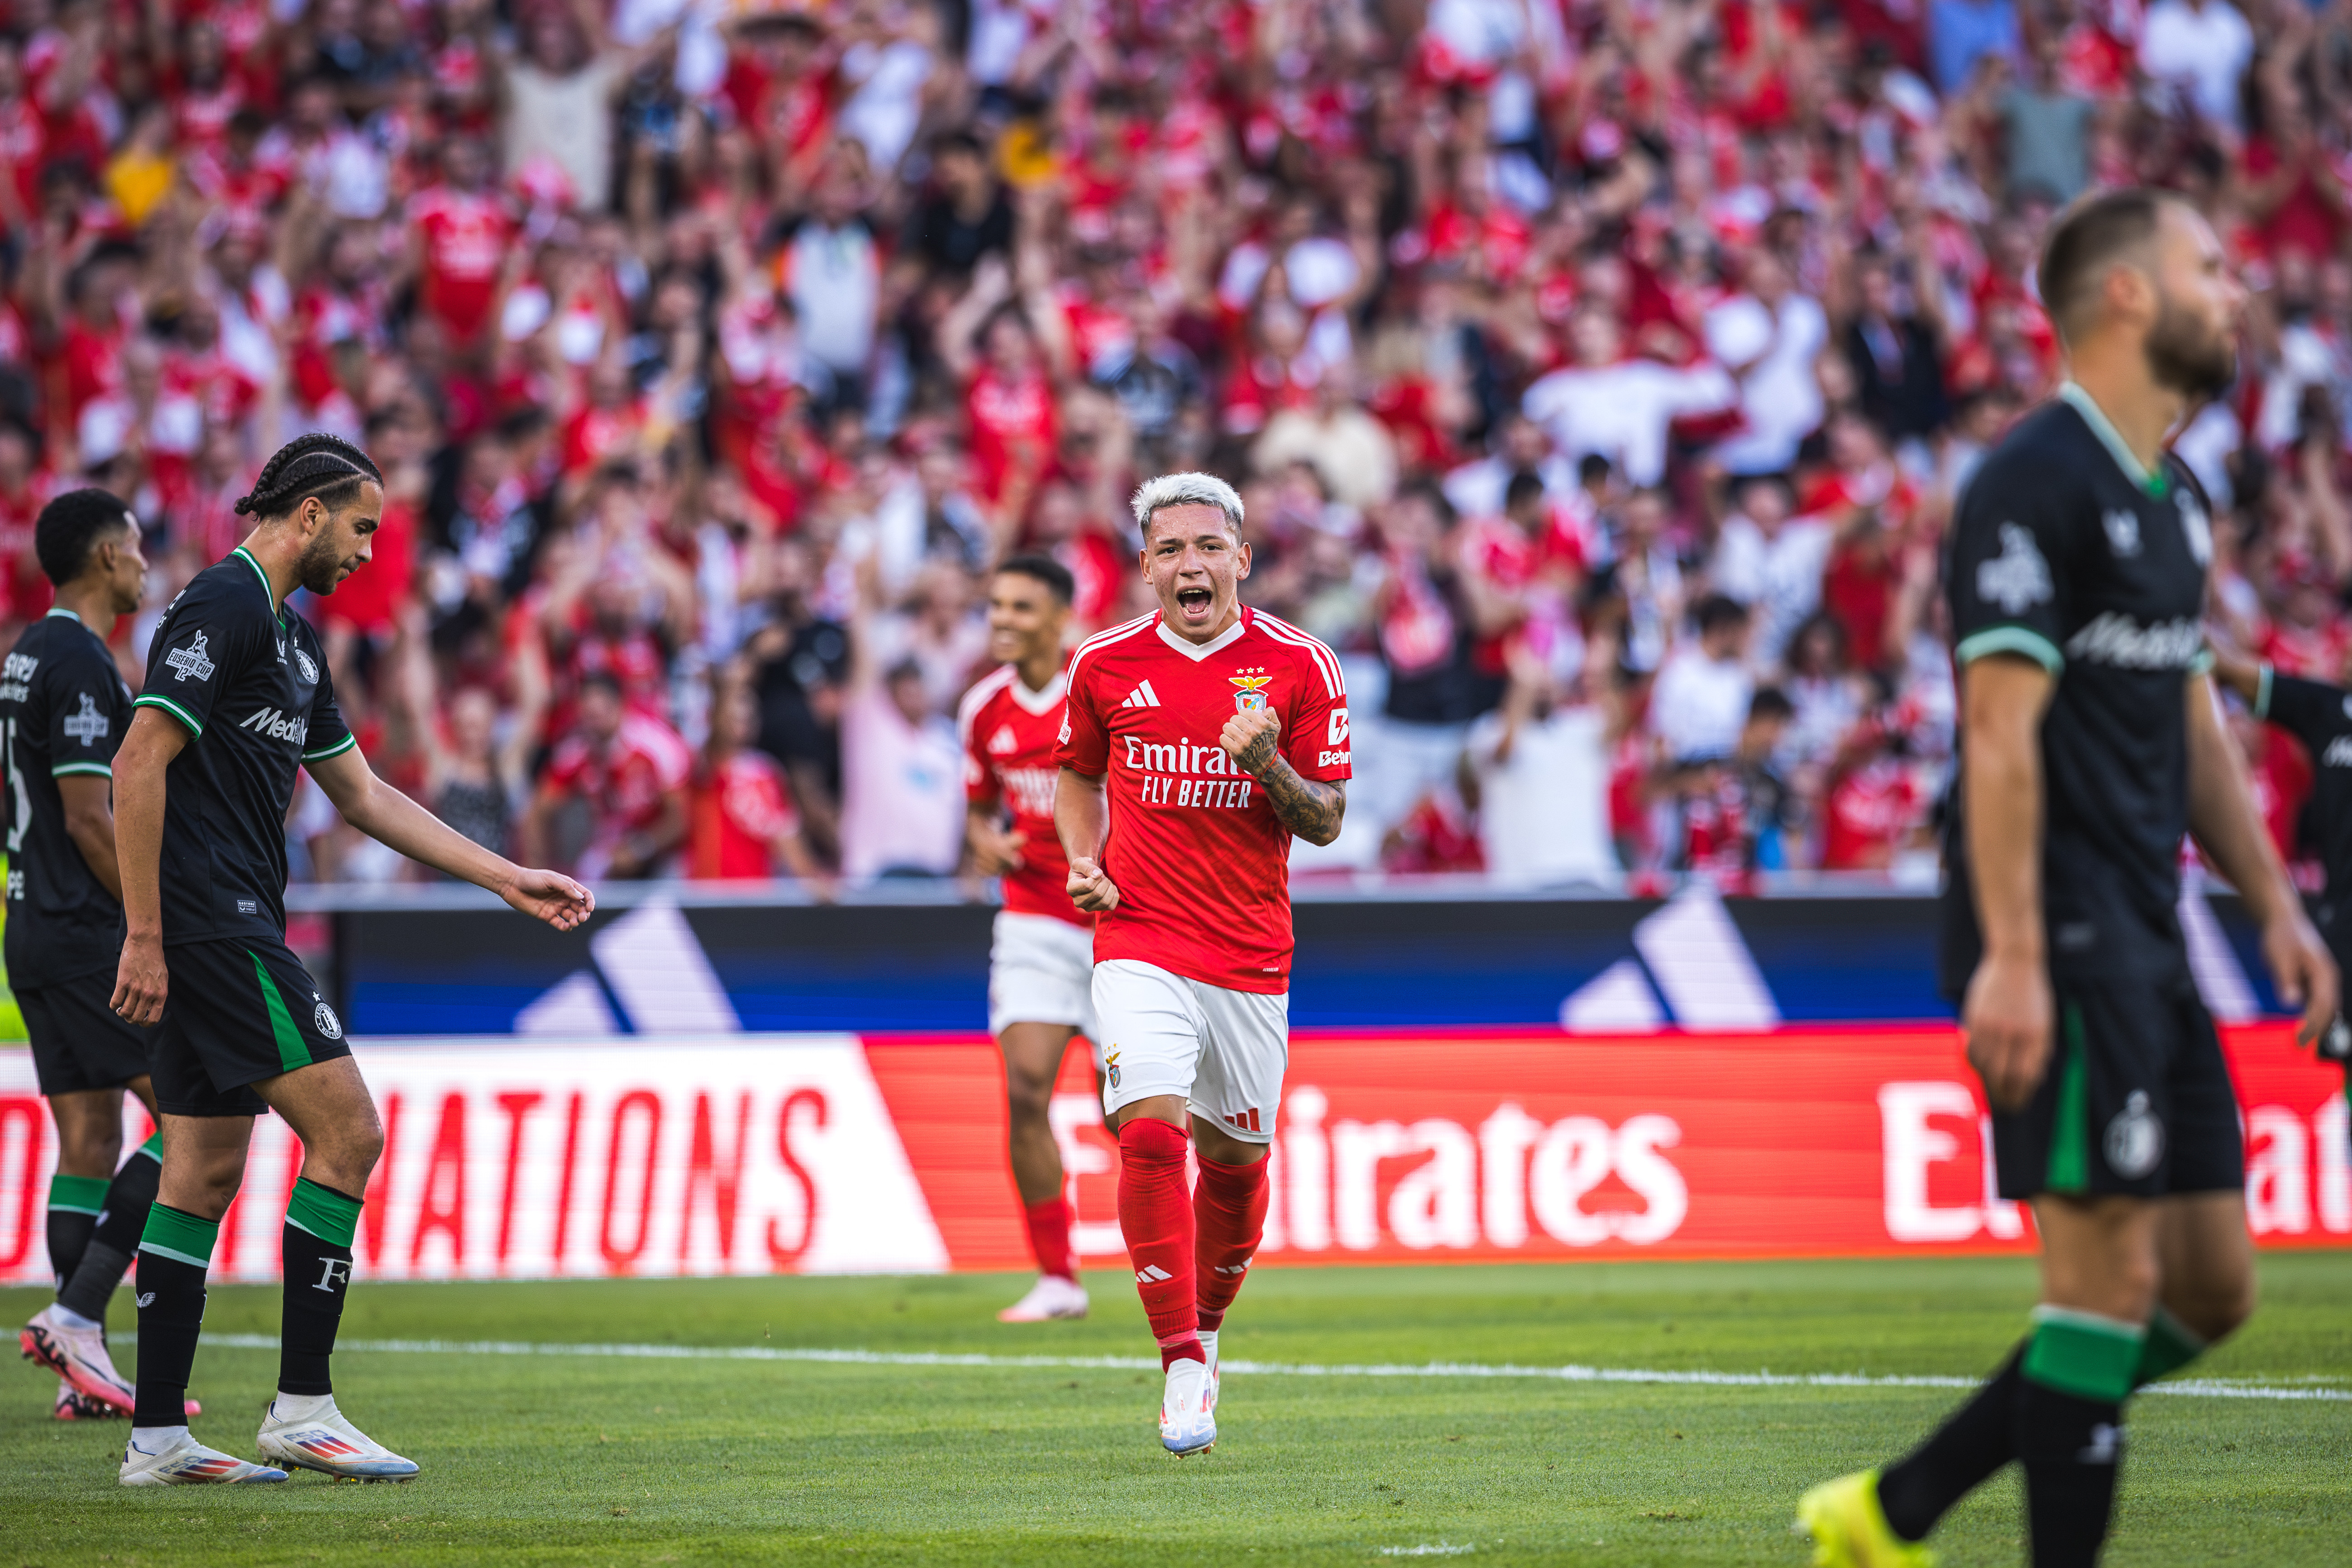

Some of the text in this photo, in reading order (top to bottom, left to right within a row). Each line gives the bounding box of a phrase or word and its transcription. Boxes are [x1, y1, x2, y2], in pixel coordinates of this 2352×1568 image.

[168, 652, 211, 675] EUSEBIO CUP
[1123, 735, 1252, 775] Emira
[1318, 750, 1351, 767] Betan
[1142, 775, 1251, 808] FLY BETTER
[283, 1429, 329, 1442] F50
[158, 1456, 202, 1474] F50
